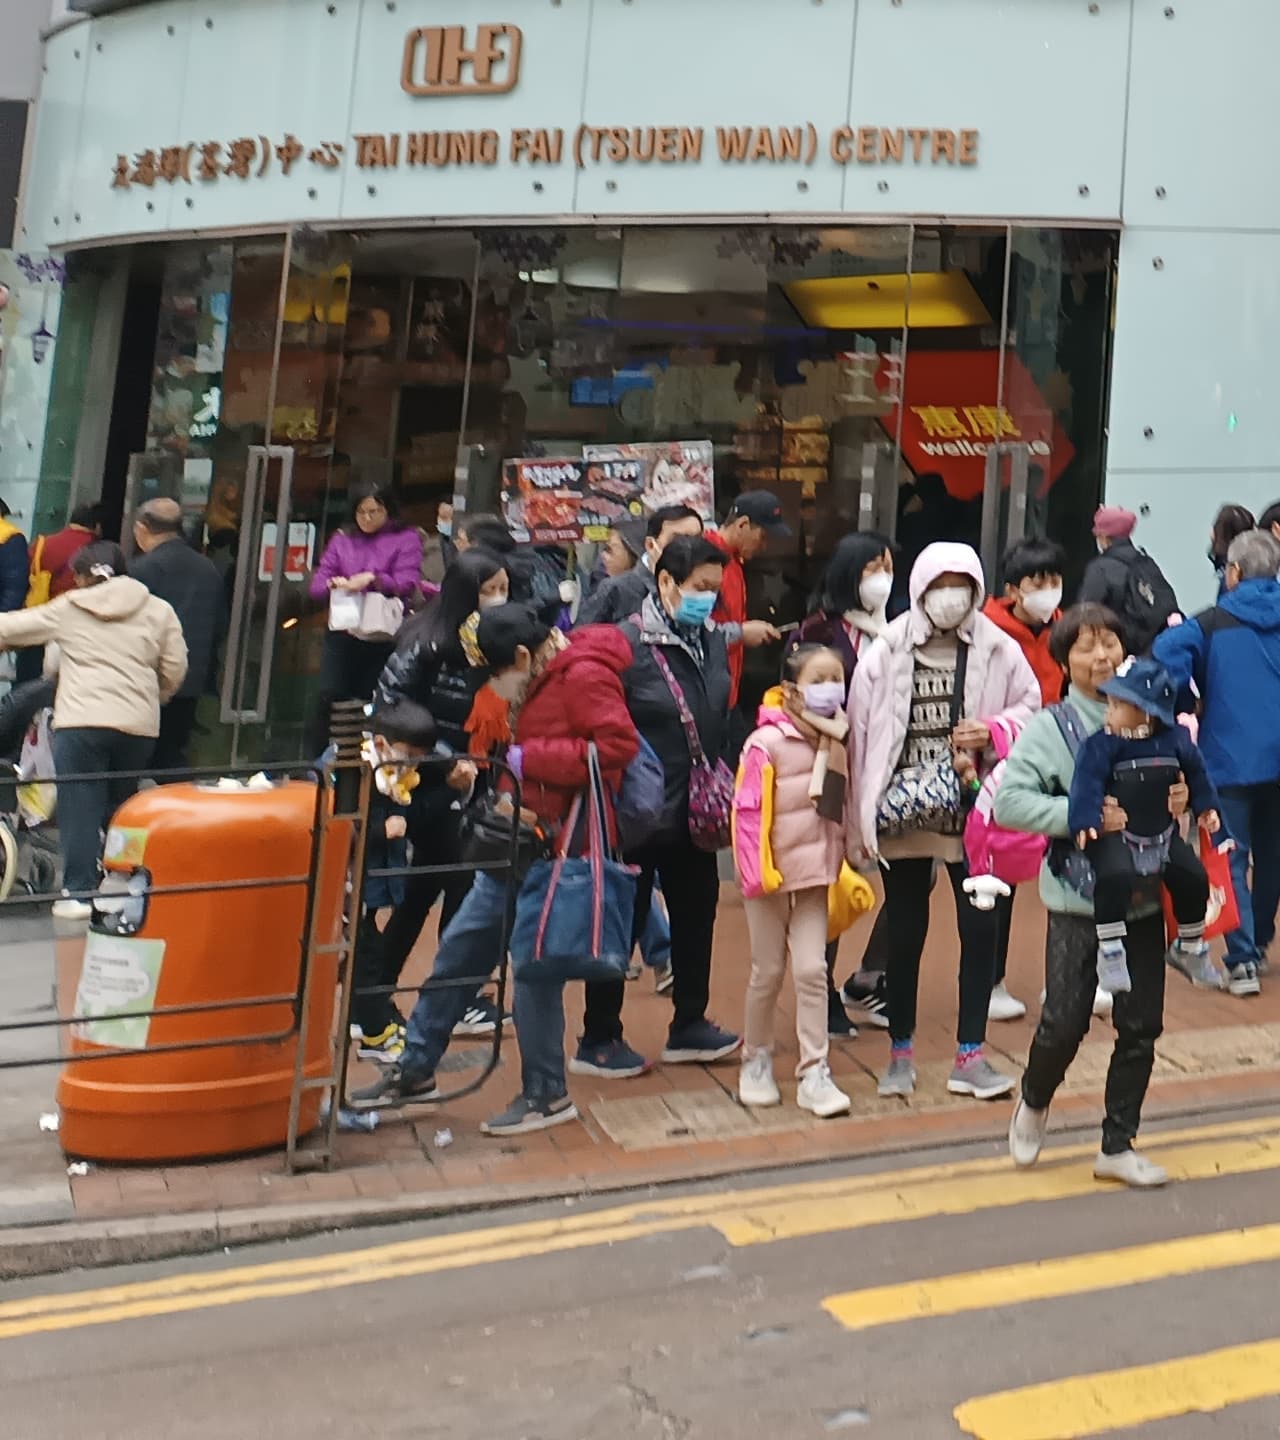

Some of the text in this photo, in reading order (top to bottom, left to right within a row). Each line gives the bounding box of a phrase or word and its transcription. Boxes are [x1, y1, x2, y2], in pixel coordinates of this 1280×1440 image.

[353, 132, 398, 169] TAI
[407, 129, 499, 168] HUNG
[510, 126, 565, 165] FAI
[573, 122, 704, 169] (TSUEN
[716, 121, 818, 166] WAN)
[829, 126, 980, 167] CENTRE
[910, 403, 1022, 439] 惠康
[918, 439, 1051, 459] wellce
